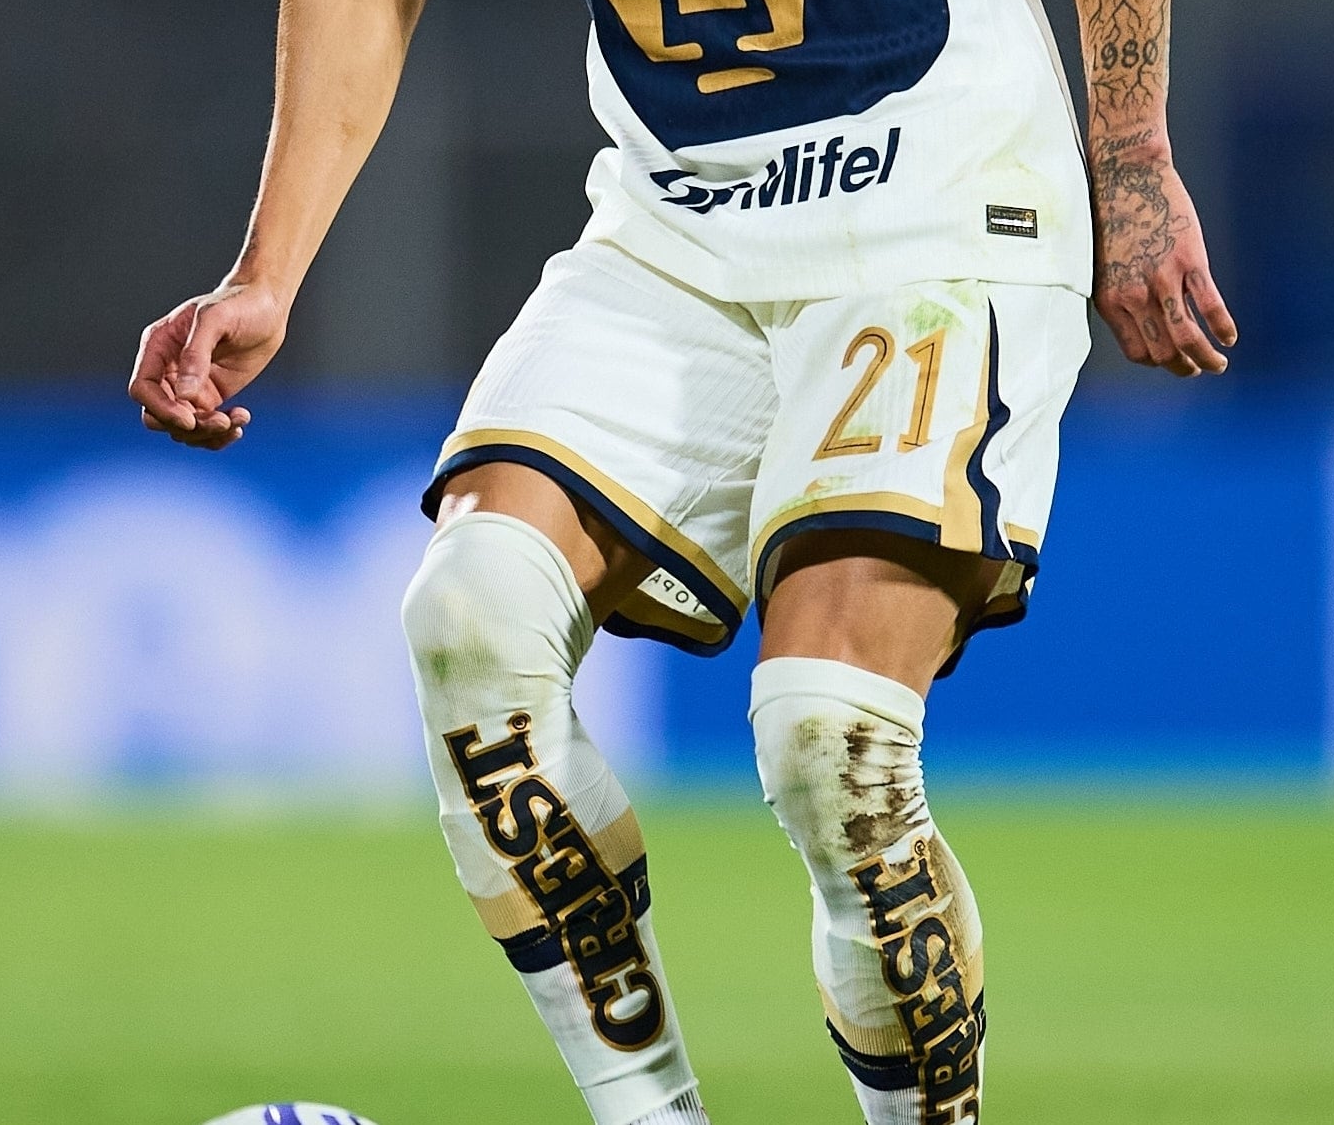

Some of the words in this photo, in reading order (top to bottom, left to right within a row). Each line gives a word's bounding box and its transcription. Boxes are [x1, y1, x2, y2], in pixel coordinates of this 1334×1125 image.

[1092, 38, 1158, 71] 1980
[740, 126, 901, 210] Mifel
[812, 326, 947, 461] 21
[443, 721, 666, 1053] CREST
